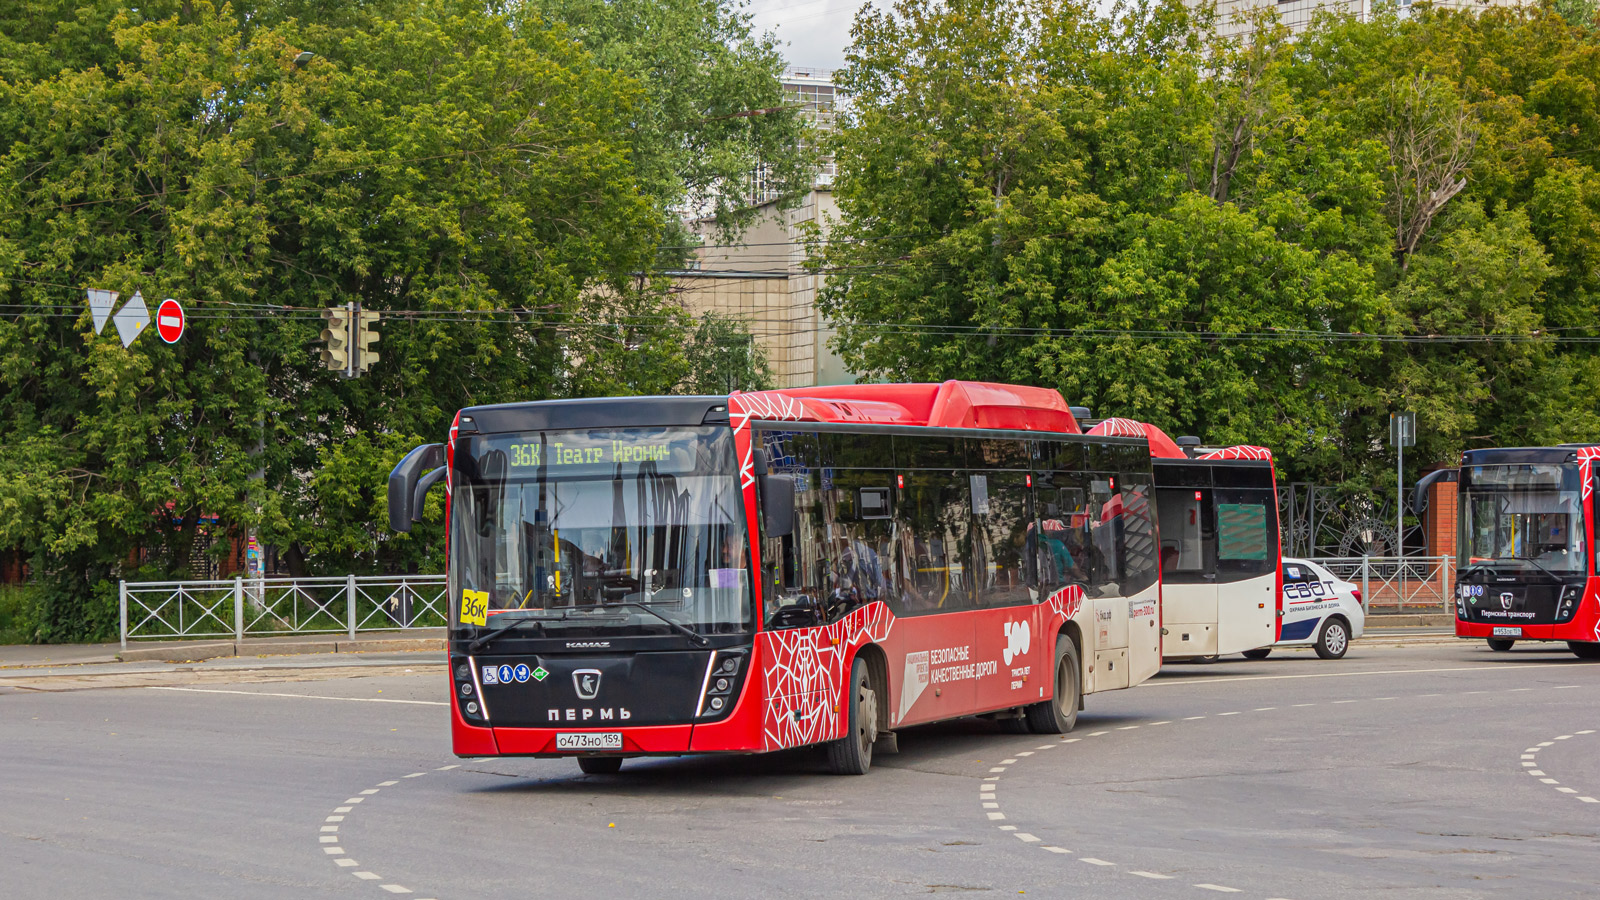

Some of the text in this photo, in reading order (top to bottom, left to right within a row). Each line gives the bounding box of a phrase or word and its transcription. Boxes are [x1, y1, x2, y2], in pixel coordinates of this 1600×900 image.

[554, 442, 603, 465] Театр
[1481, 609, 1536, 620] Пермский транспорт
[930, 645, 970, 665] БЕЗОПАСНЫЕ
[930, 660, 998, 684] КАЧЕСТВЕННЫЕ ДОРОГИ
[548, 707, 631, 721] ПЕРМЬ
[603, 734, 619, 743] 159
